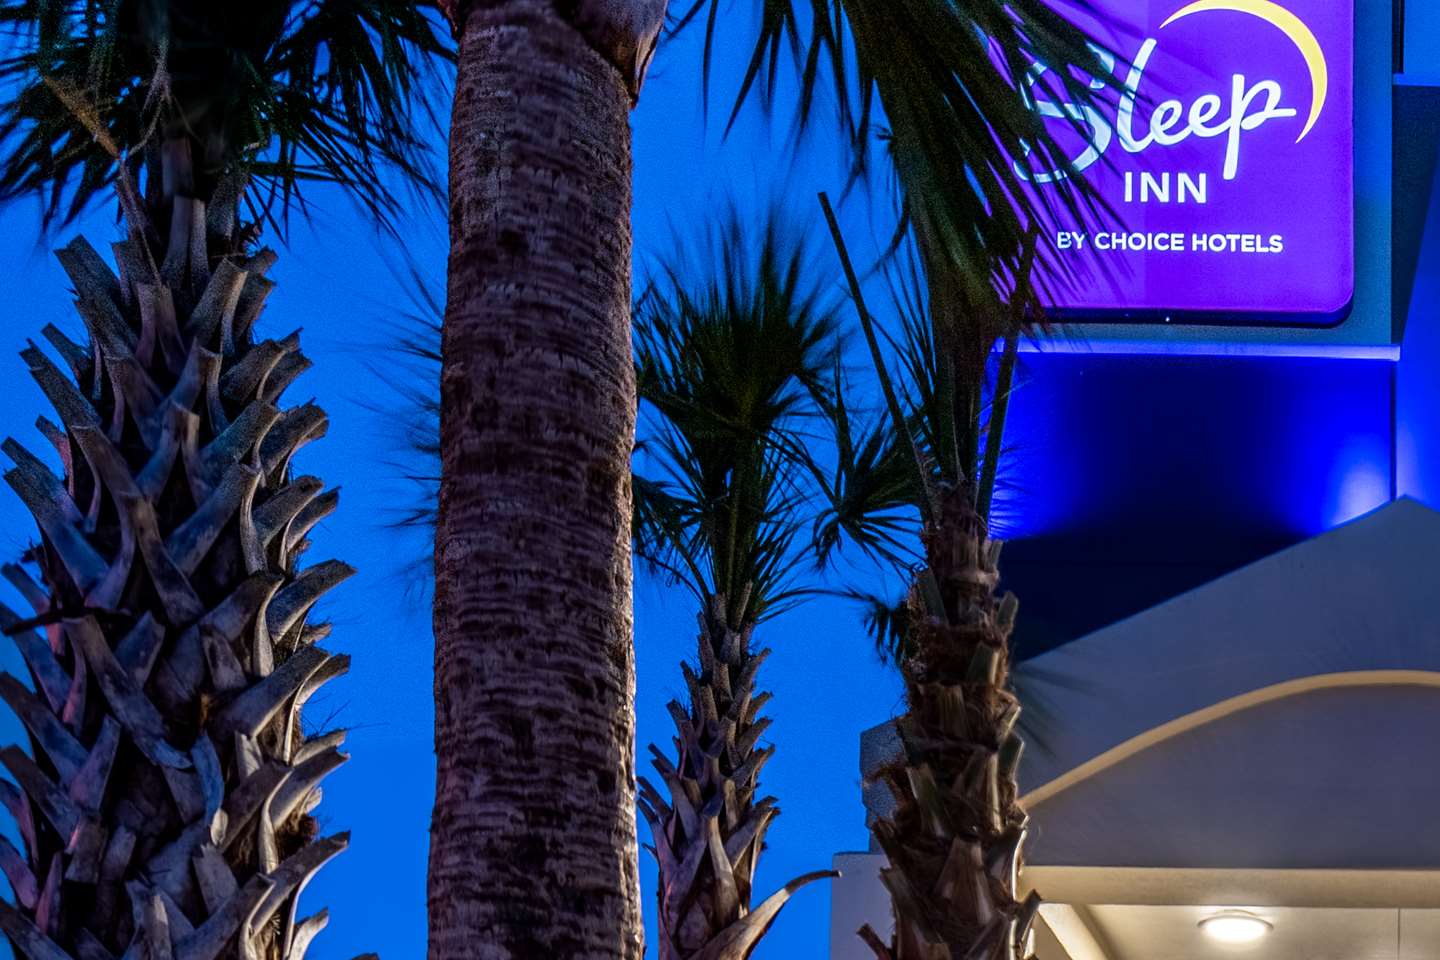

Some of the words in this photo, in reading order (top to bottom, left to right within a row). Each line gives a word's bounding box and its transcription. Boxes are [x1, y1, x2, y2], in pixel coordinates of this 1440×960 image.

[1013, 38, 1297, 182] Sleep
[1124, 171, 1207, 204] INN
[1057, 231, 1086, 249] BY
[1094, 232, 1185, 251] CHOICE
[1191, 234, 1283, 253] HOTELS
